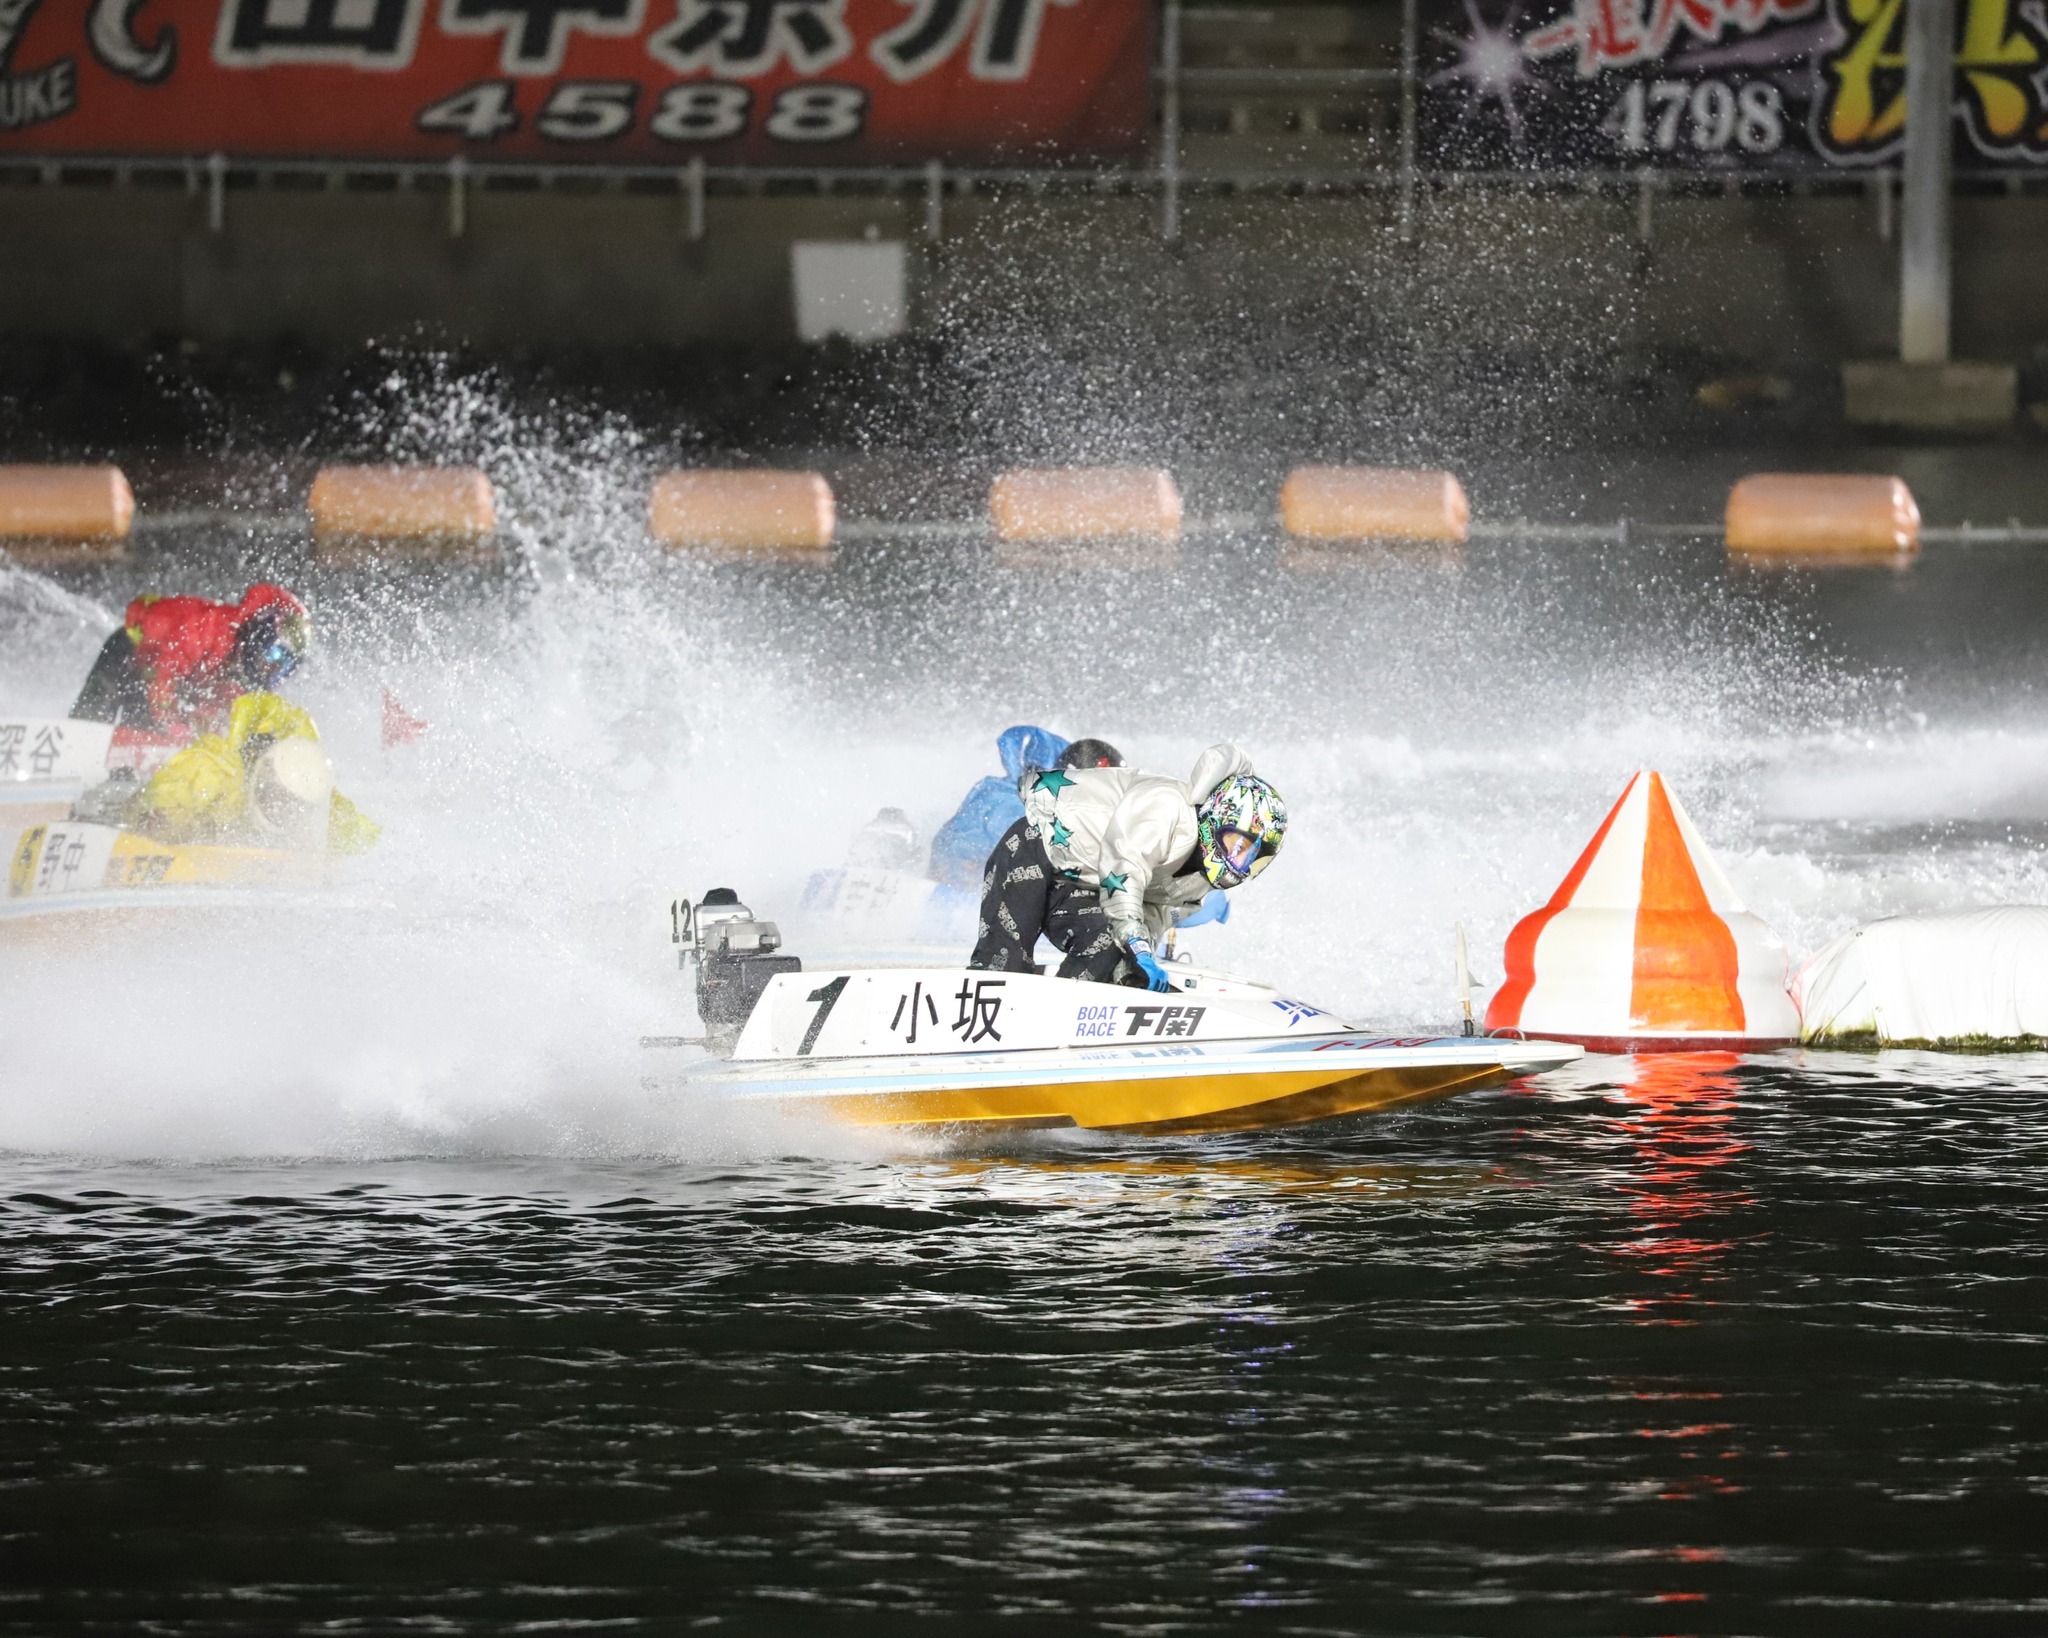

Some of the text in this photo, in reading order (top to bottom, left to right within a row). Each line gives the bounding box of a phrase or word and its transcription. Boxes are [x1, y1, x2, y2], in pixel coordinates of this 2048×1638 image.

[419, 81, 866, 140] 4588
[1603, 79, 1784, 153] 4798
[671, 898, 692, 943] 12
[797, 975, 1006, 1055] 1 小坂
[1076, 1022, 1117, 1037] RACE
[1077, 1006, 1118, 1020] BOAT
[1124, 1006, 1207, 1036] 下関
